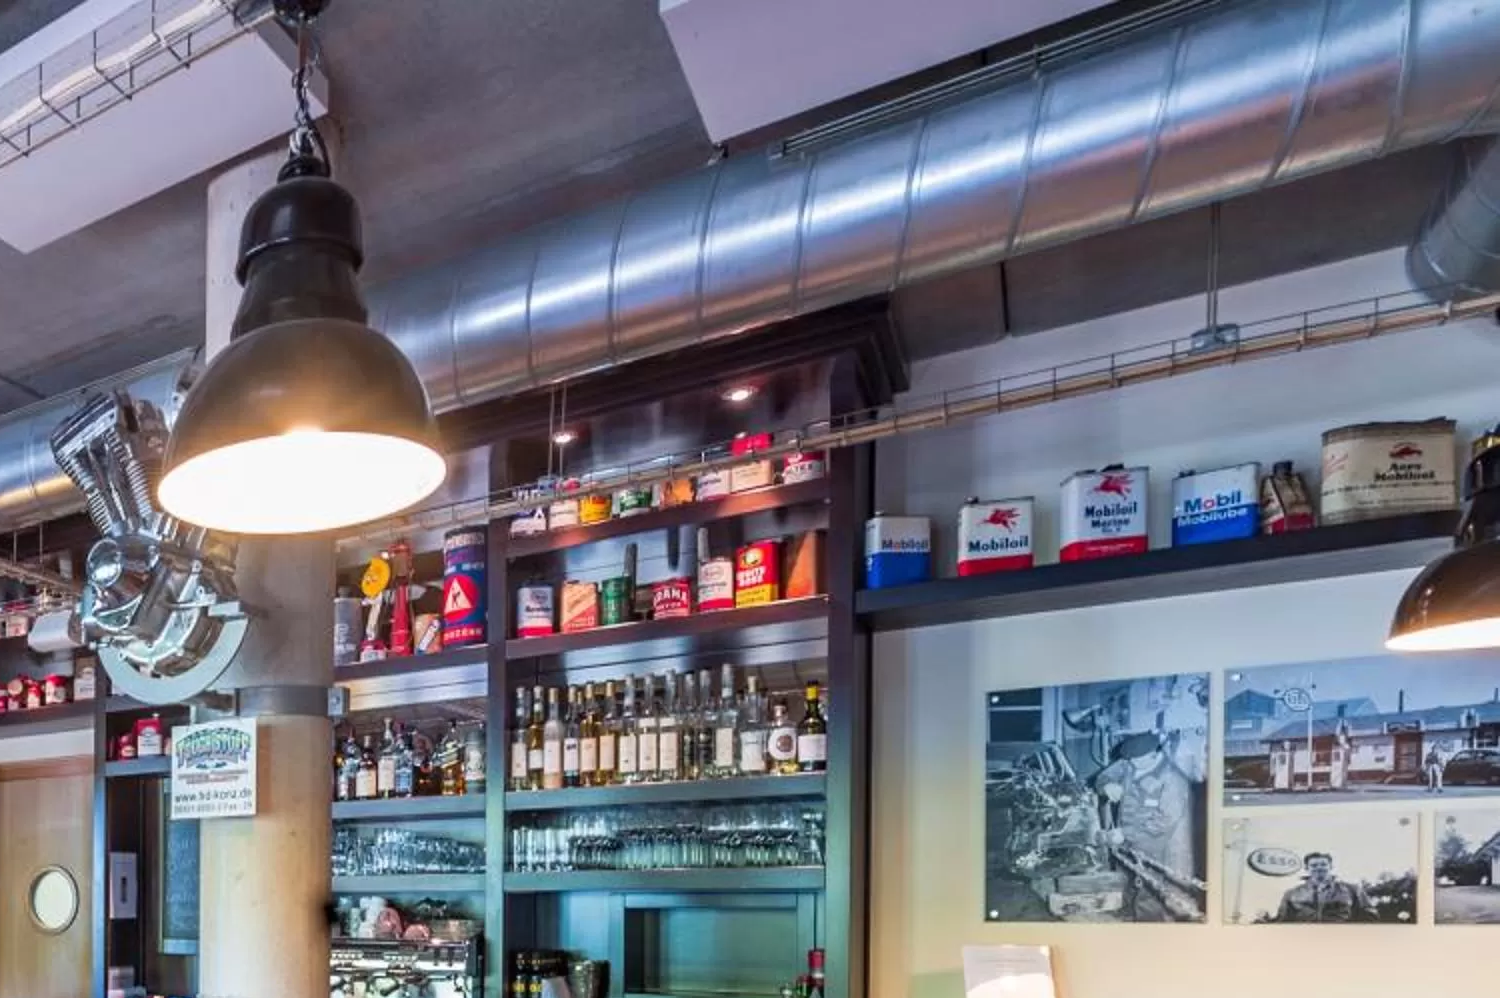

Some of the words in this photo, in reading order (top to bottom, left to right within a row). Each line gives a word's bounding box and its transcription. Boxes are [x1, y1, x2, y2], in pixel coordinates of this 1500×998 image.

[1084, 500, 1138, 520] Mobiloil
[1183, 488, 1241, 513] Mobil
[1177, 507, 1248, 527] Mobilube
[882, 538, 929, 551] Mobiloil
[968, 535, 1029, 554] Mobiloil
[1256, 853, 1298, 867] Esso
